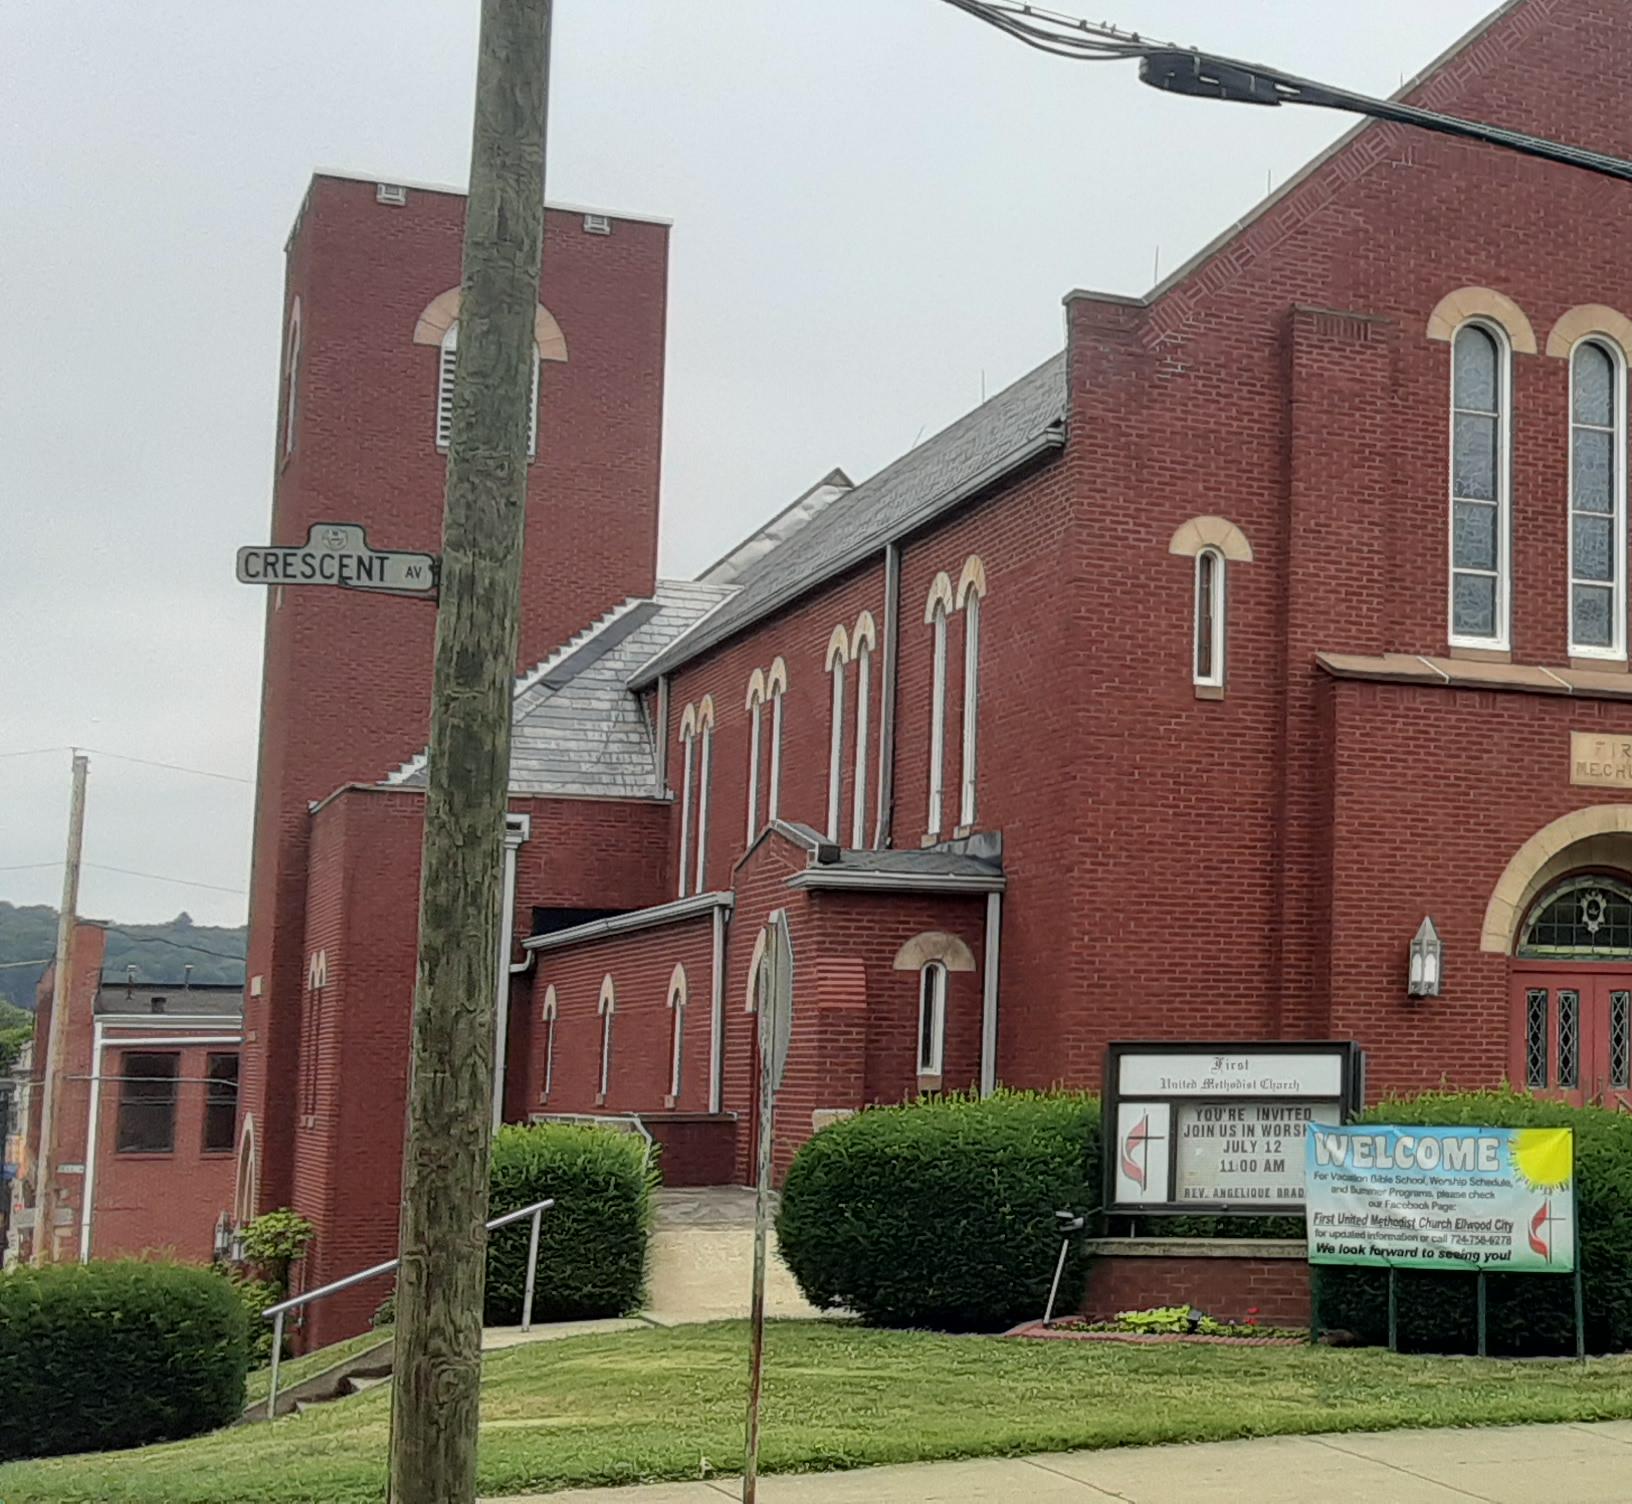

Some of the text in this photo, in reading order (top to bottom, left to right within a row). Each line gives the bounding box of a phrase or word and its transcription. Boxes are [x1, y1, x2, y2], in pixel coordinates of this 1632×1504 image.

[244, 552, 422, 582] CRESCENT AV
[1211, 1057, 1249, 1073] First
[1160, 1078, 1300, 1092] United Methodist Church
[1195, 1108, 1312, 1121] YOU'RE INVITED
[1184, 1124, 1215, 1138] JOIN
[1220, 1124, 1237, 1138] US
[1242, 1124, 1255, 1138] IN
[1223, 1140, 1282, 1153] JULY 12
[1314, 1132, 1500, 1172] WELCOME
[1264, 1159, 1285, 1173] AM
[1313, 1170, 1328, 1180] For
[1331, 1172, 1368, 1182] Vacation
[1370, 1174, 1393, 1183] Bible
[1430, 1176, 1467, 1187] Worship
[1184, 1187, 1208, 1199] REV.
[1213, 1187, 1270, 1199] ANGELIQUE
[1331, 1185, 1348, 1194] and
[1436, 1190, 1466, 1199] please
[1468, 1190, 1495, 1199] check
[1368, 1200, 1456, 1213] our Facebook Page:
[1314, 1212, 1514, 1233] First United Methodist Church Ellwood City
[1315, 1228, 1326, 1237] for
[1329, 1230, 1365, 1240] updated
[1367, 1231, 1418, 1241] information
[1432, 1233, 1447, 1243] call
[1316, 1243, 1512, 1263] We look forward to seeing you!
